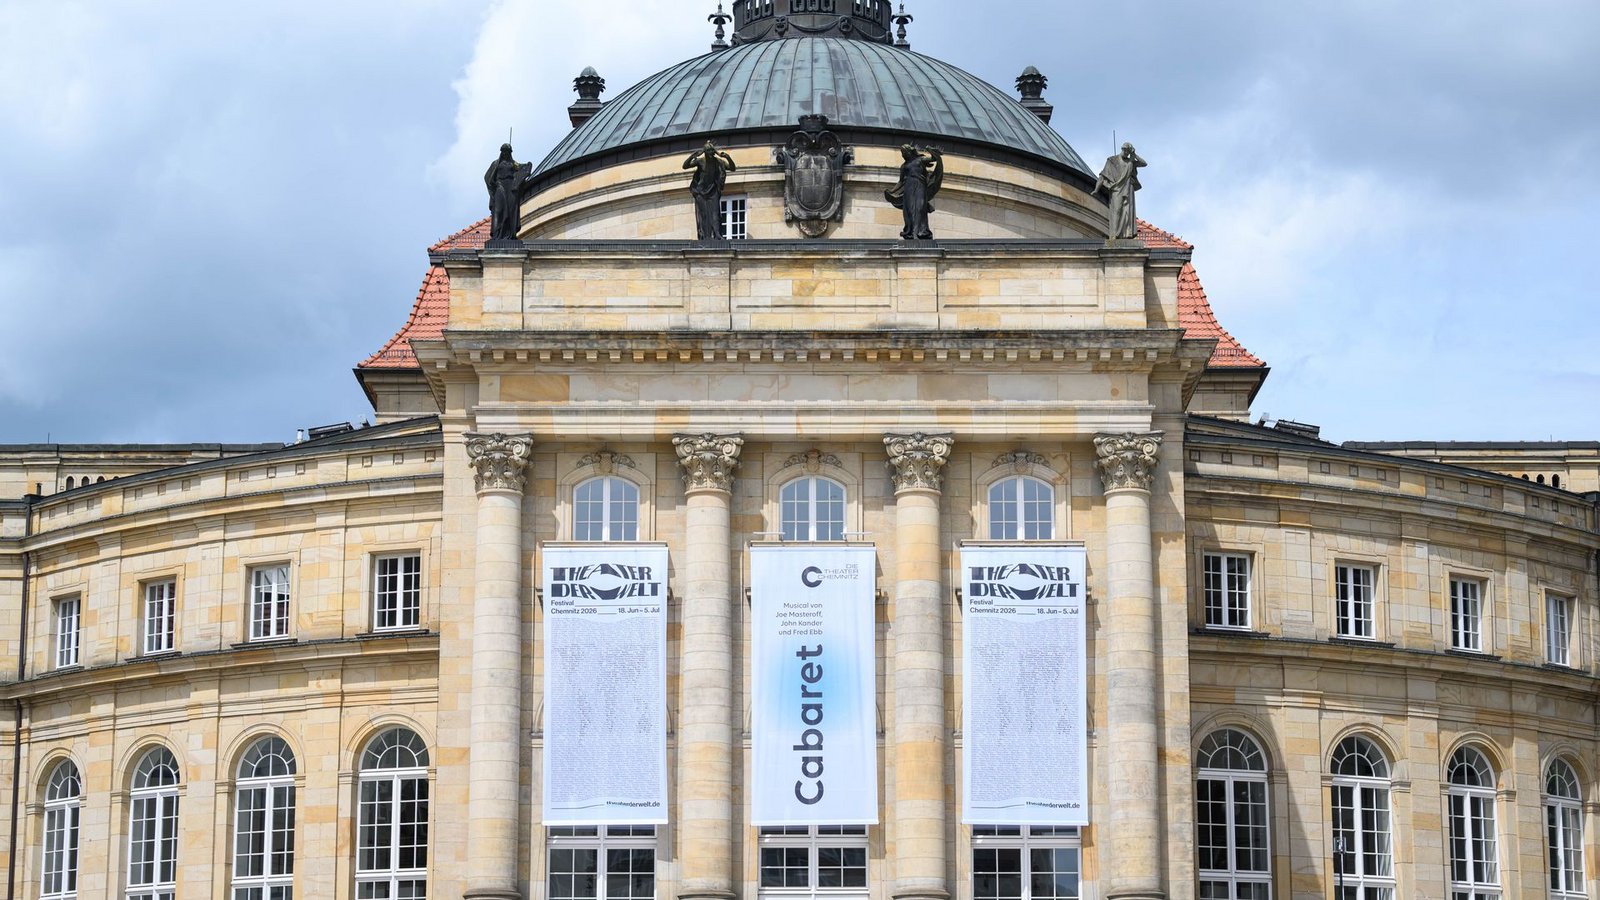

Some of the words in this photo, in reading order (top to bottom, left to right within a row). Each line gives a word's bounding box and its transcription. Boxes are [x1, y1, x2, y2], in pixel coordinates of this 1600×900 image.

[550, 563, 652, 581] THEATER
[968, 563, 1070, 581] THEATER
[792, 643, 824, 805] Cabaret
